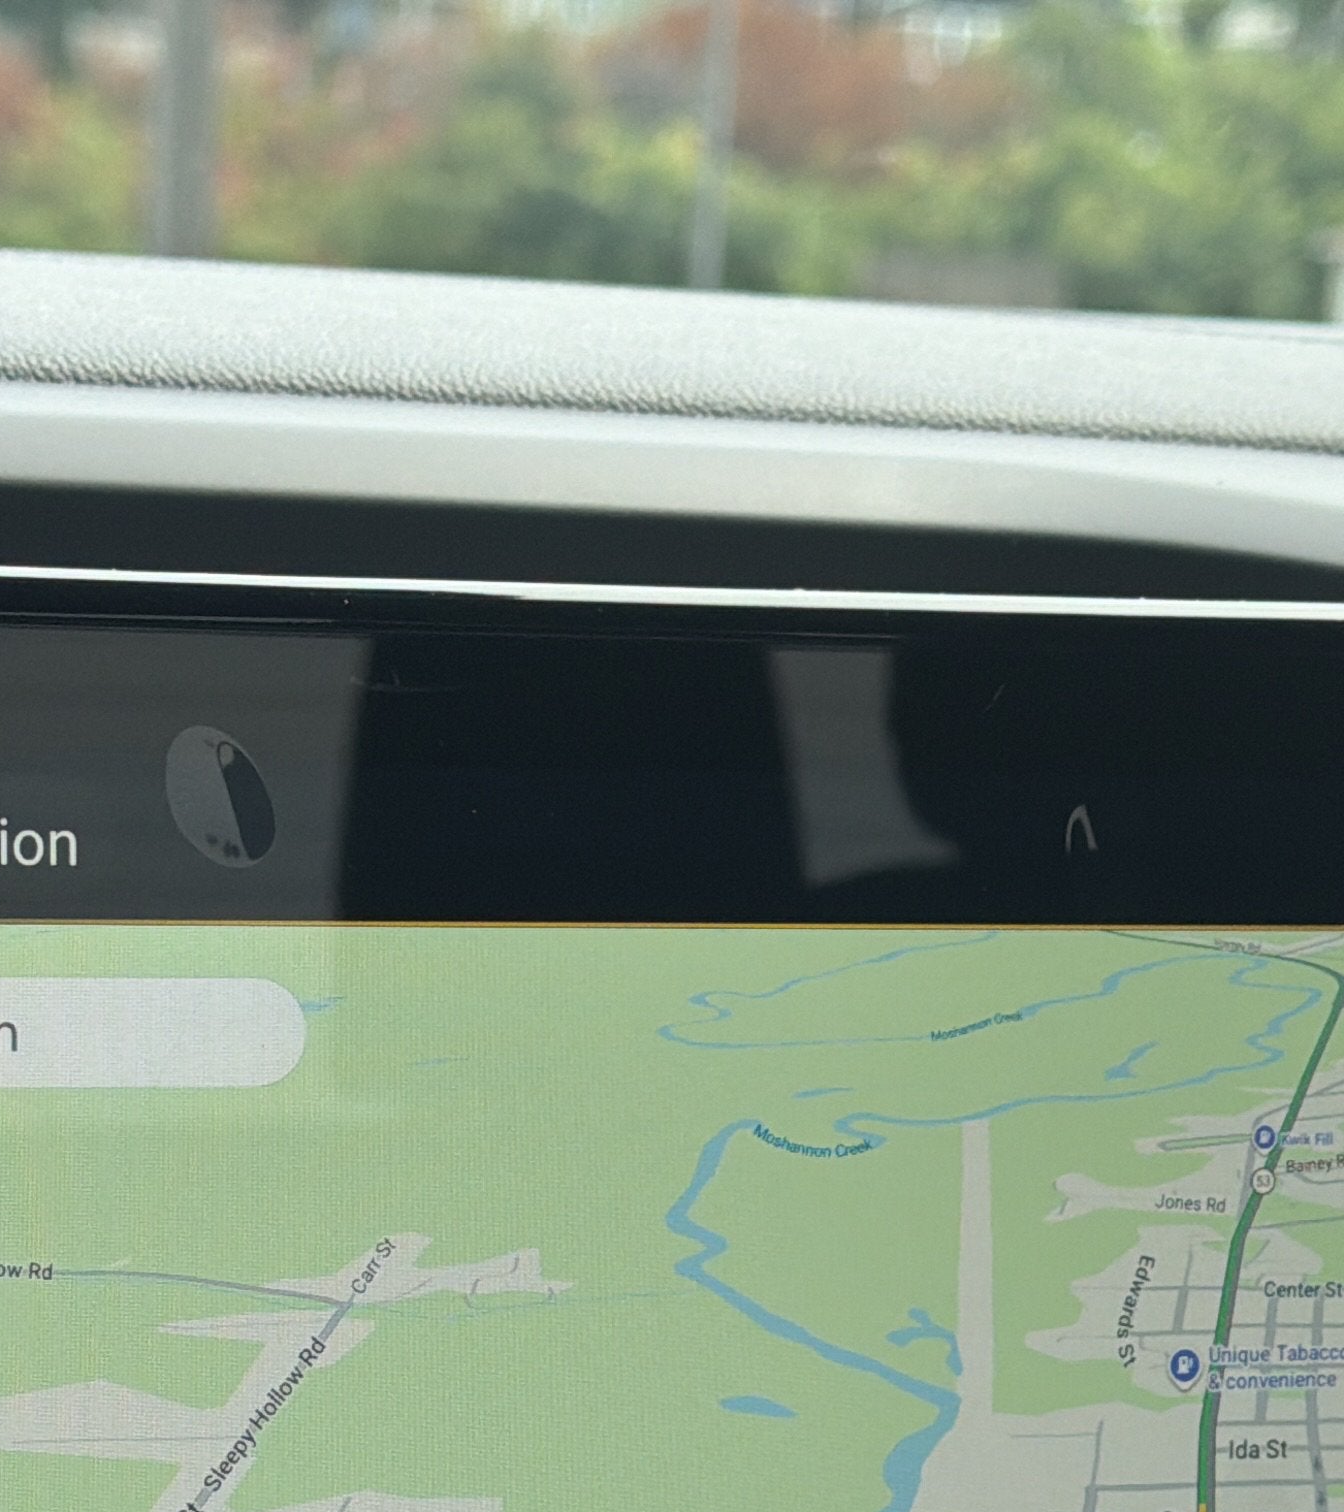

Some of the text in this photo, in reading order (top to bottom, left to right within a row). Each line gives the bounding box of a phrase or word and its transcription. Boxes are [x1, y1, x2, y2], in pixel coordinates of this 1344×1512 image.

[753, 1124, 873, 1158] Moshannon Creek
[1315, 1132, 1334, 1147] Fill
[1155, 1193, 1226, 1213] Jones Rd
[27, 1260, 54, 1281] Rd
[350, 1236, 397, 1296] Carr St
[1263, 1281, 1344, 1299] Center St
[1117, 1254, 1156, 1369] Edwards St
[1208, 1345, 1271, 1367] Unique
[1207, 1371, 1337, 1390] & convenience
[203, 1336, 326, 1494] Sleepy Hollow Rd
[1228, 1439, 1288, 1460] Ida St
